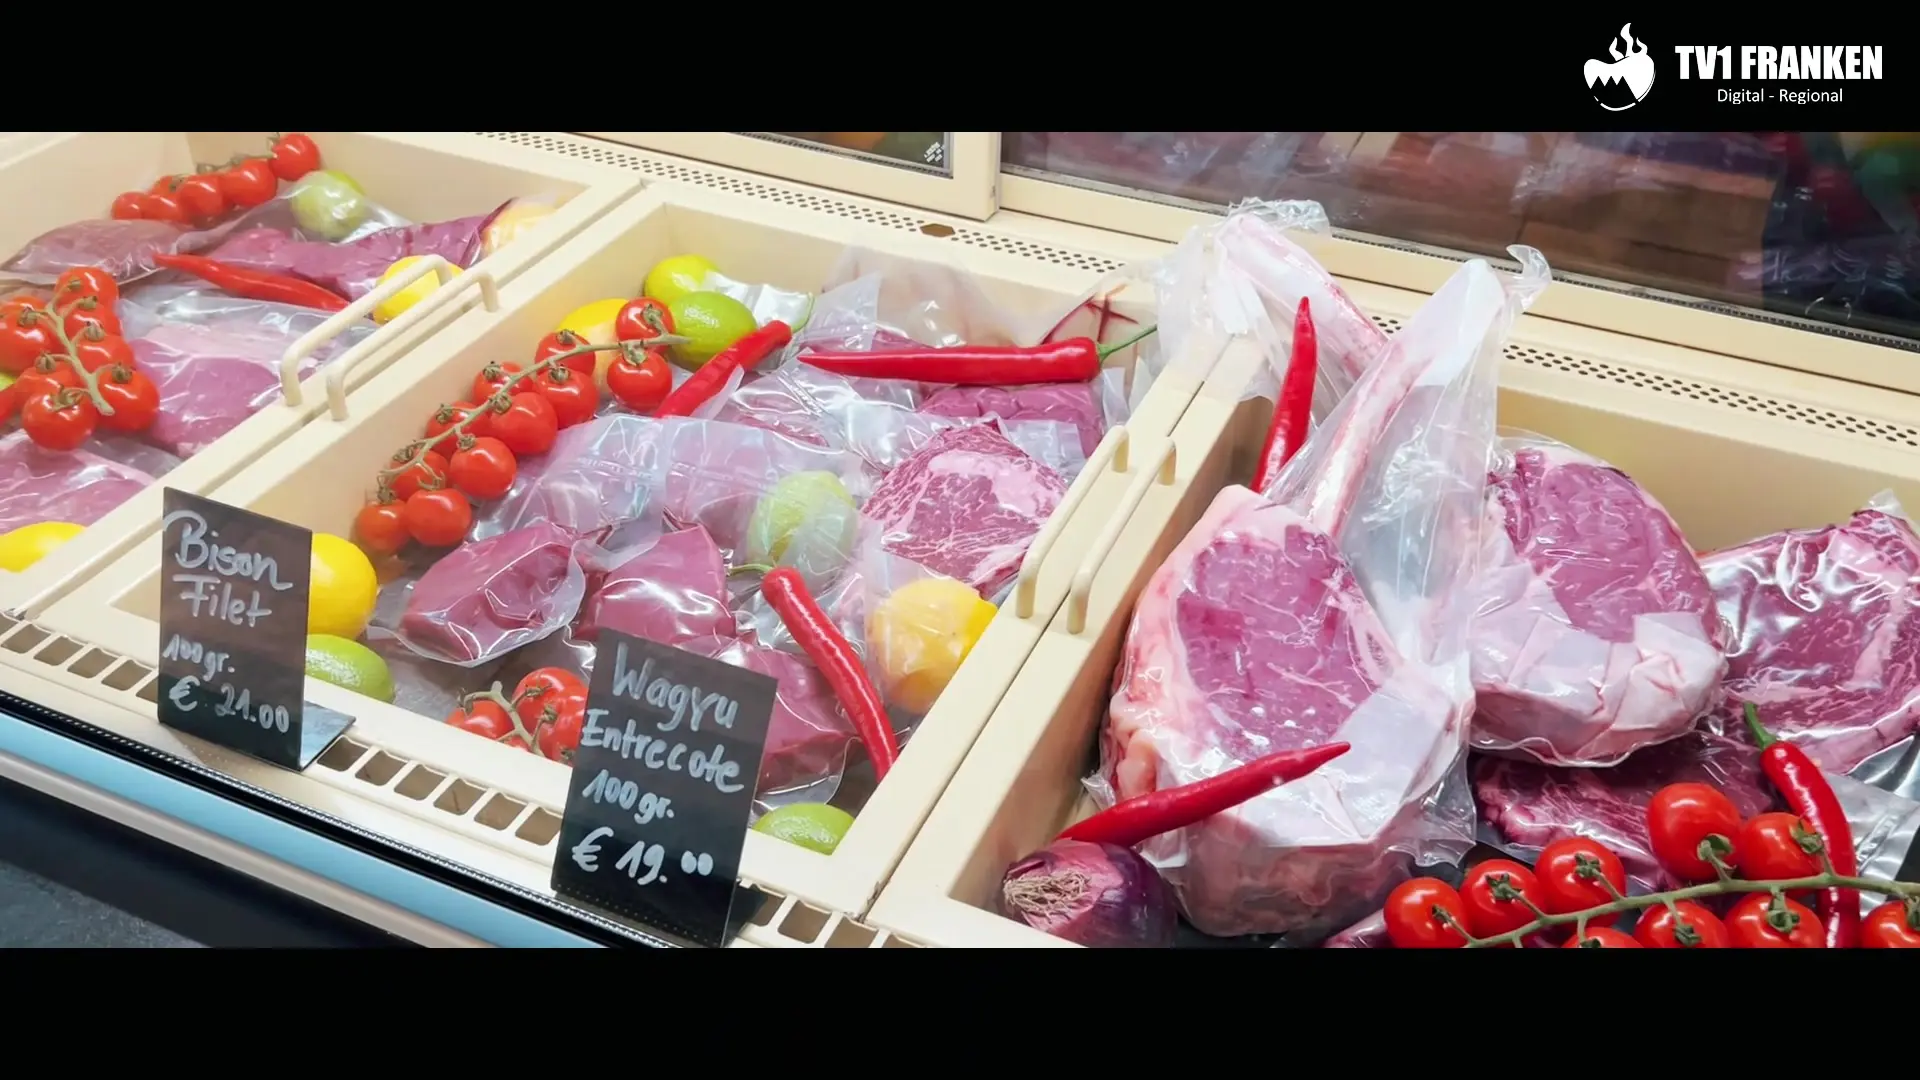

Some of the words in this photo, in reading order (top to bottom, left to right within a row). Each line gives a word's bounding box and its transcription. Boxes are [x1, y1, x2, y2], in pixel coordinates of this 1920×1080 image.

[163, 510, 293, 591] Bison
[173, 574, 272, 628] Filet
[169, 675, 200, 712] €
[612, 642, 739, 732] Wagyu
[580, 708, 744, 793] Entrecote
[571, 826, 614, 872] €
